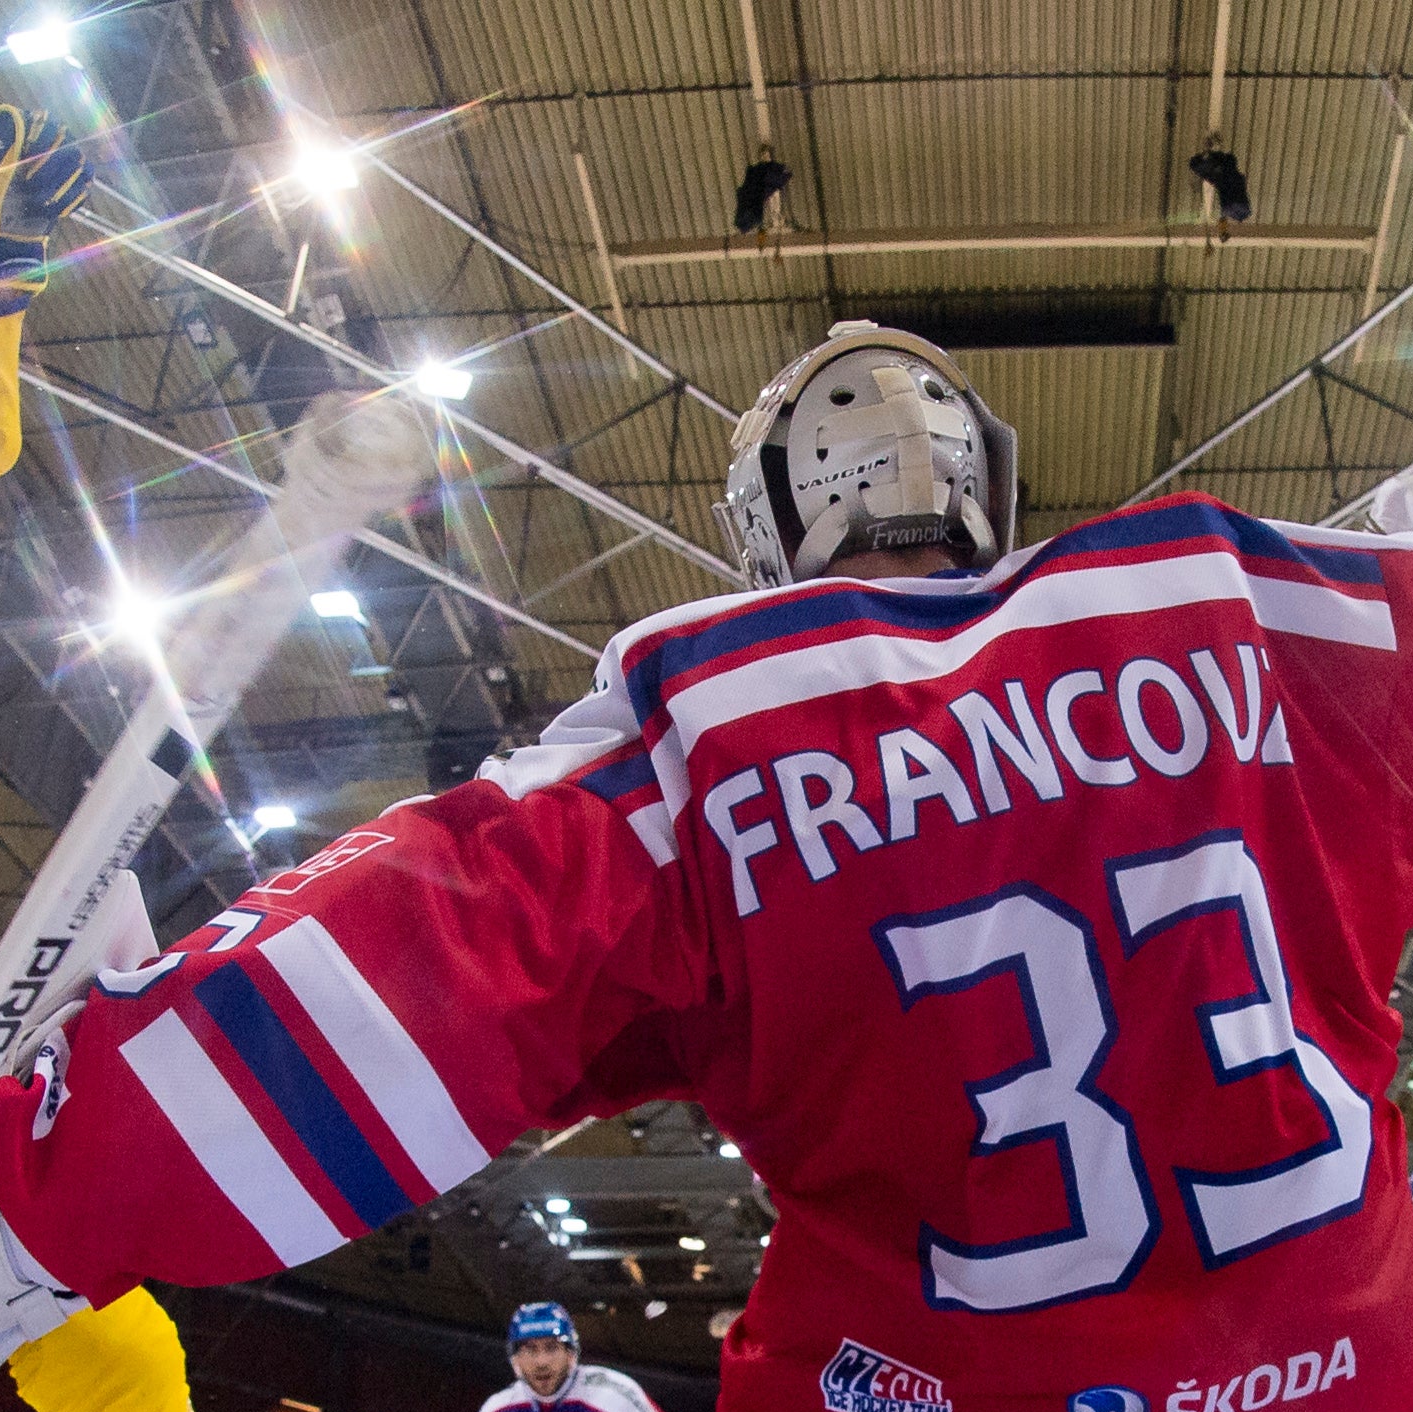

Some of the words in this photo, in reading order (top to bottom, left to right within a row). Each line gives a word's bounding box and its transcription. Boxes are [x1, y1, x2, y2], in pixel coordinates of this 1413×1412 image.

[796, 455, 890, 492] VAUGHN
[866, 520, 953, 550] Francik
[870, 827, 1374, 1315] 33
[827, 1389, 851, 1411] ICE
